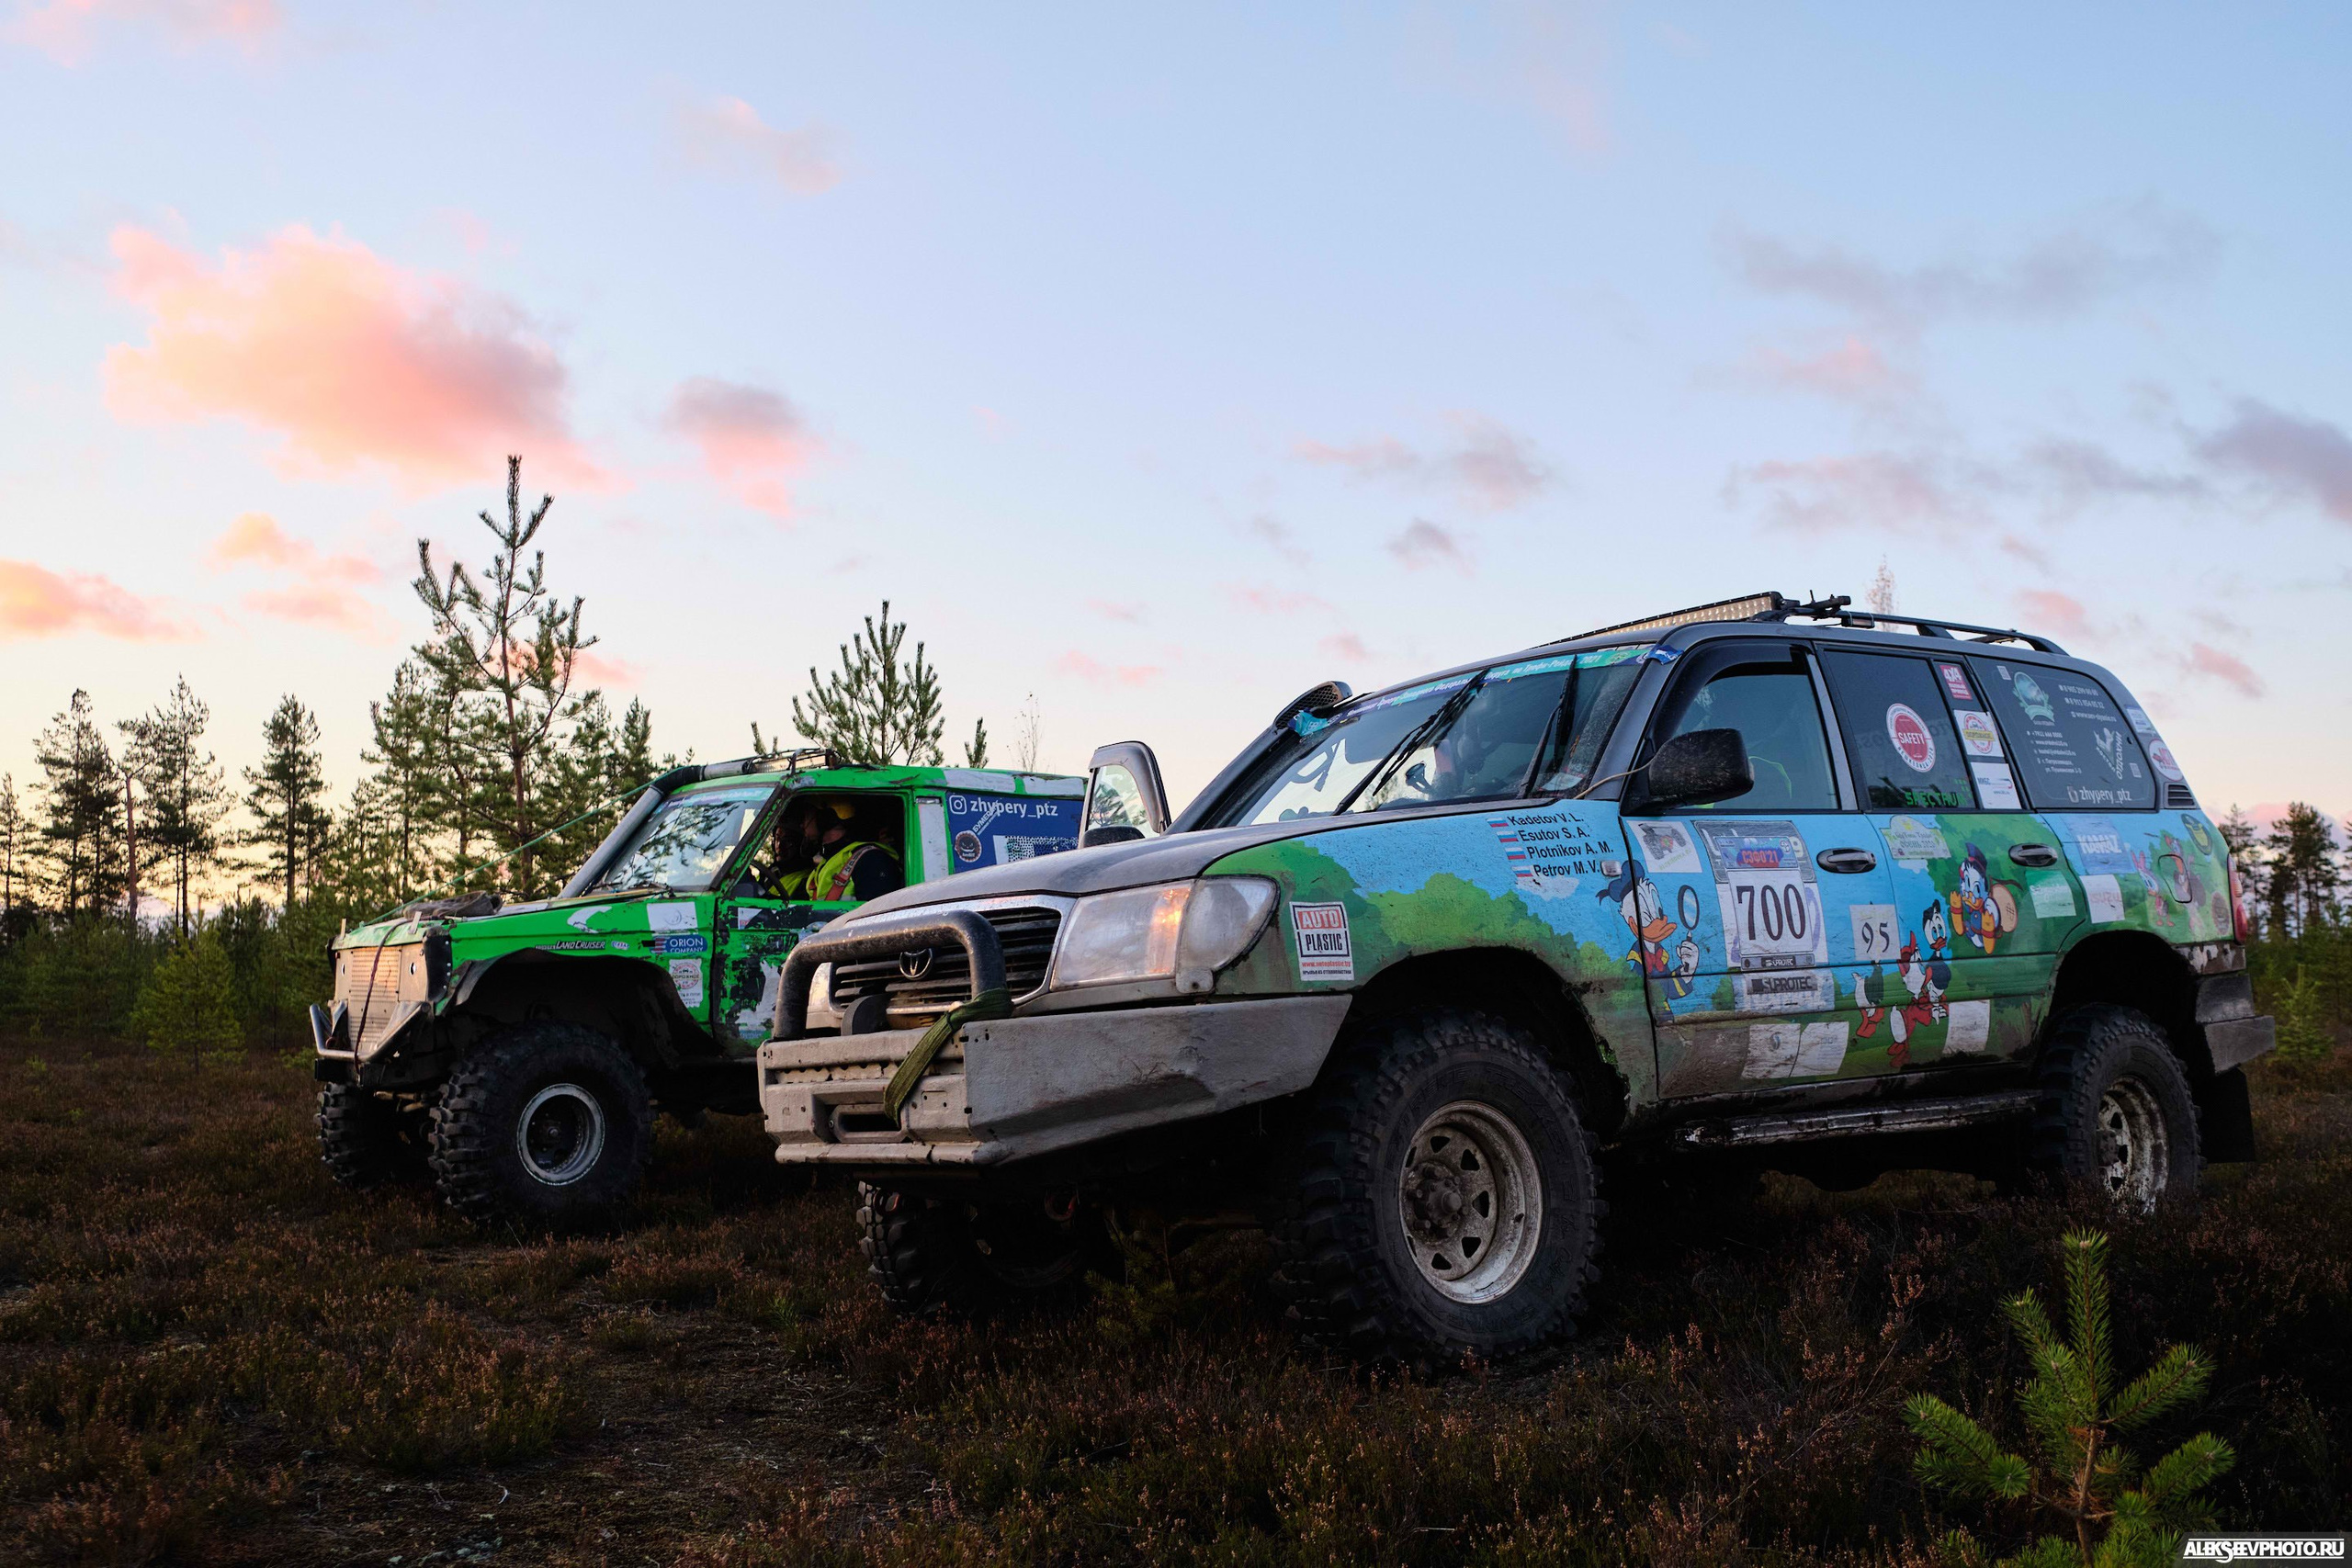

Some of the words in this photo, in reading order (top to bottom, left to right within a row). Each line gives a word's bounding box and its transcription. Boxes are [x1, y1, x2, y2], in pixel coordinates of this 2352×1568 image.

[1579, 654, 1602, 664] 2021
[1897, 732, 1926, 745] SAFETY
[2079, 786, 2132, 804] zhypery_ptz
[970, 797, 1058, 818] zhypery_ptz
[1508, 815, 1557, 826] Kadetov
[1556, 813, 1572, 823] V.
[1569, 812, 1584, 822] L.
[1518, 829, 1560, 842] Esutov
[1562, 827, 1576, 839] S.
[1577, 827, 1590, 838] A.
[1526, 844, 1581, 859] Plotnikov
[1585, 842, 1598, 854] A.
[1598, 840, 1614, 853] M.
[1533, 863, 1571, 877] Petrov
[1573, 861, 1589, 874] M.
[1588, 860, 1600, 873] V.
[1302, 909, 1340, 929] AUTO
[1736, 884, 1806, 942] 700
[670, 938, 703, 947] ORION
[1306, 933, 1343, 952] PLASTIC
[1861, 921, 1890, 953] 95
